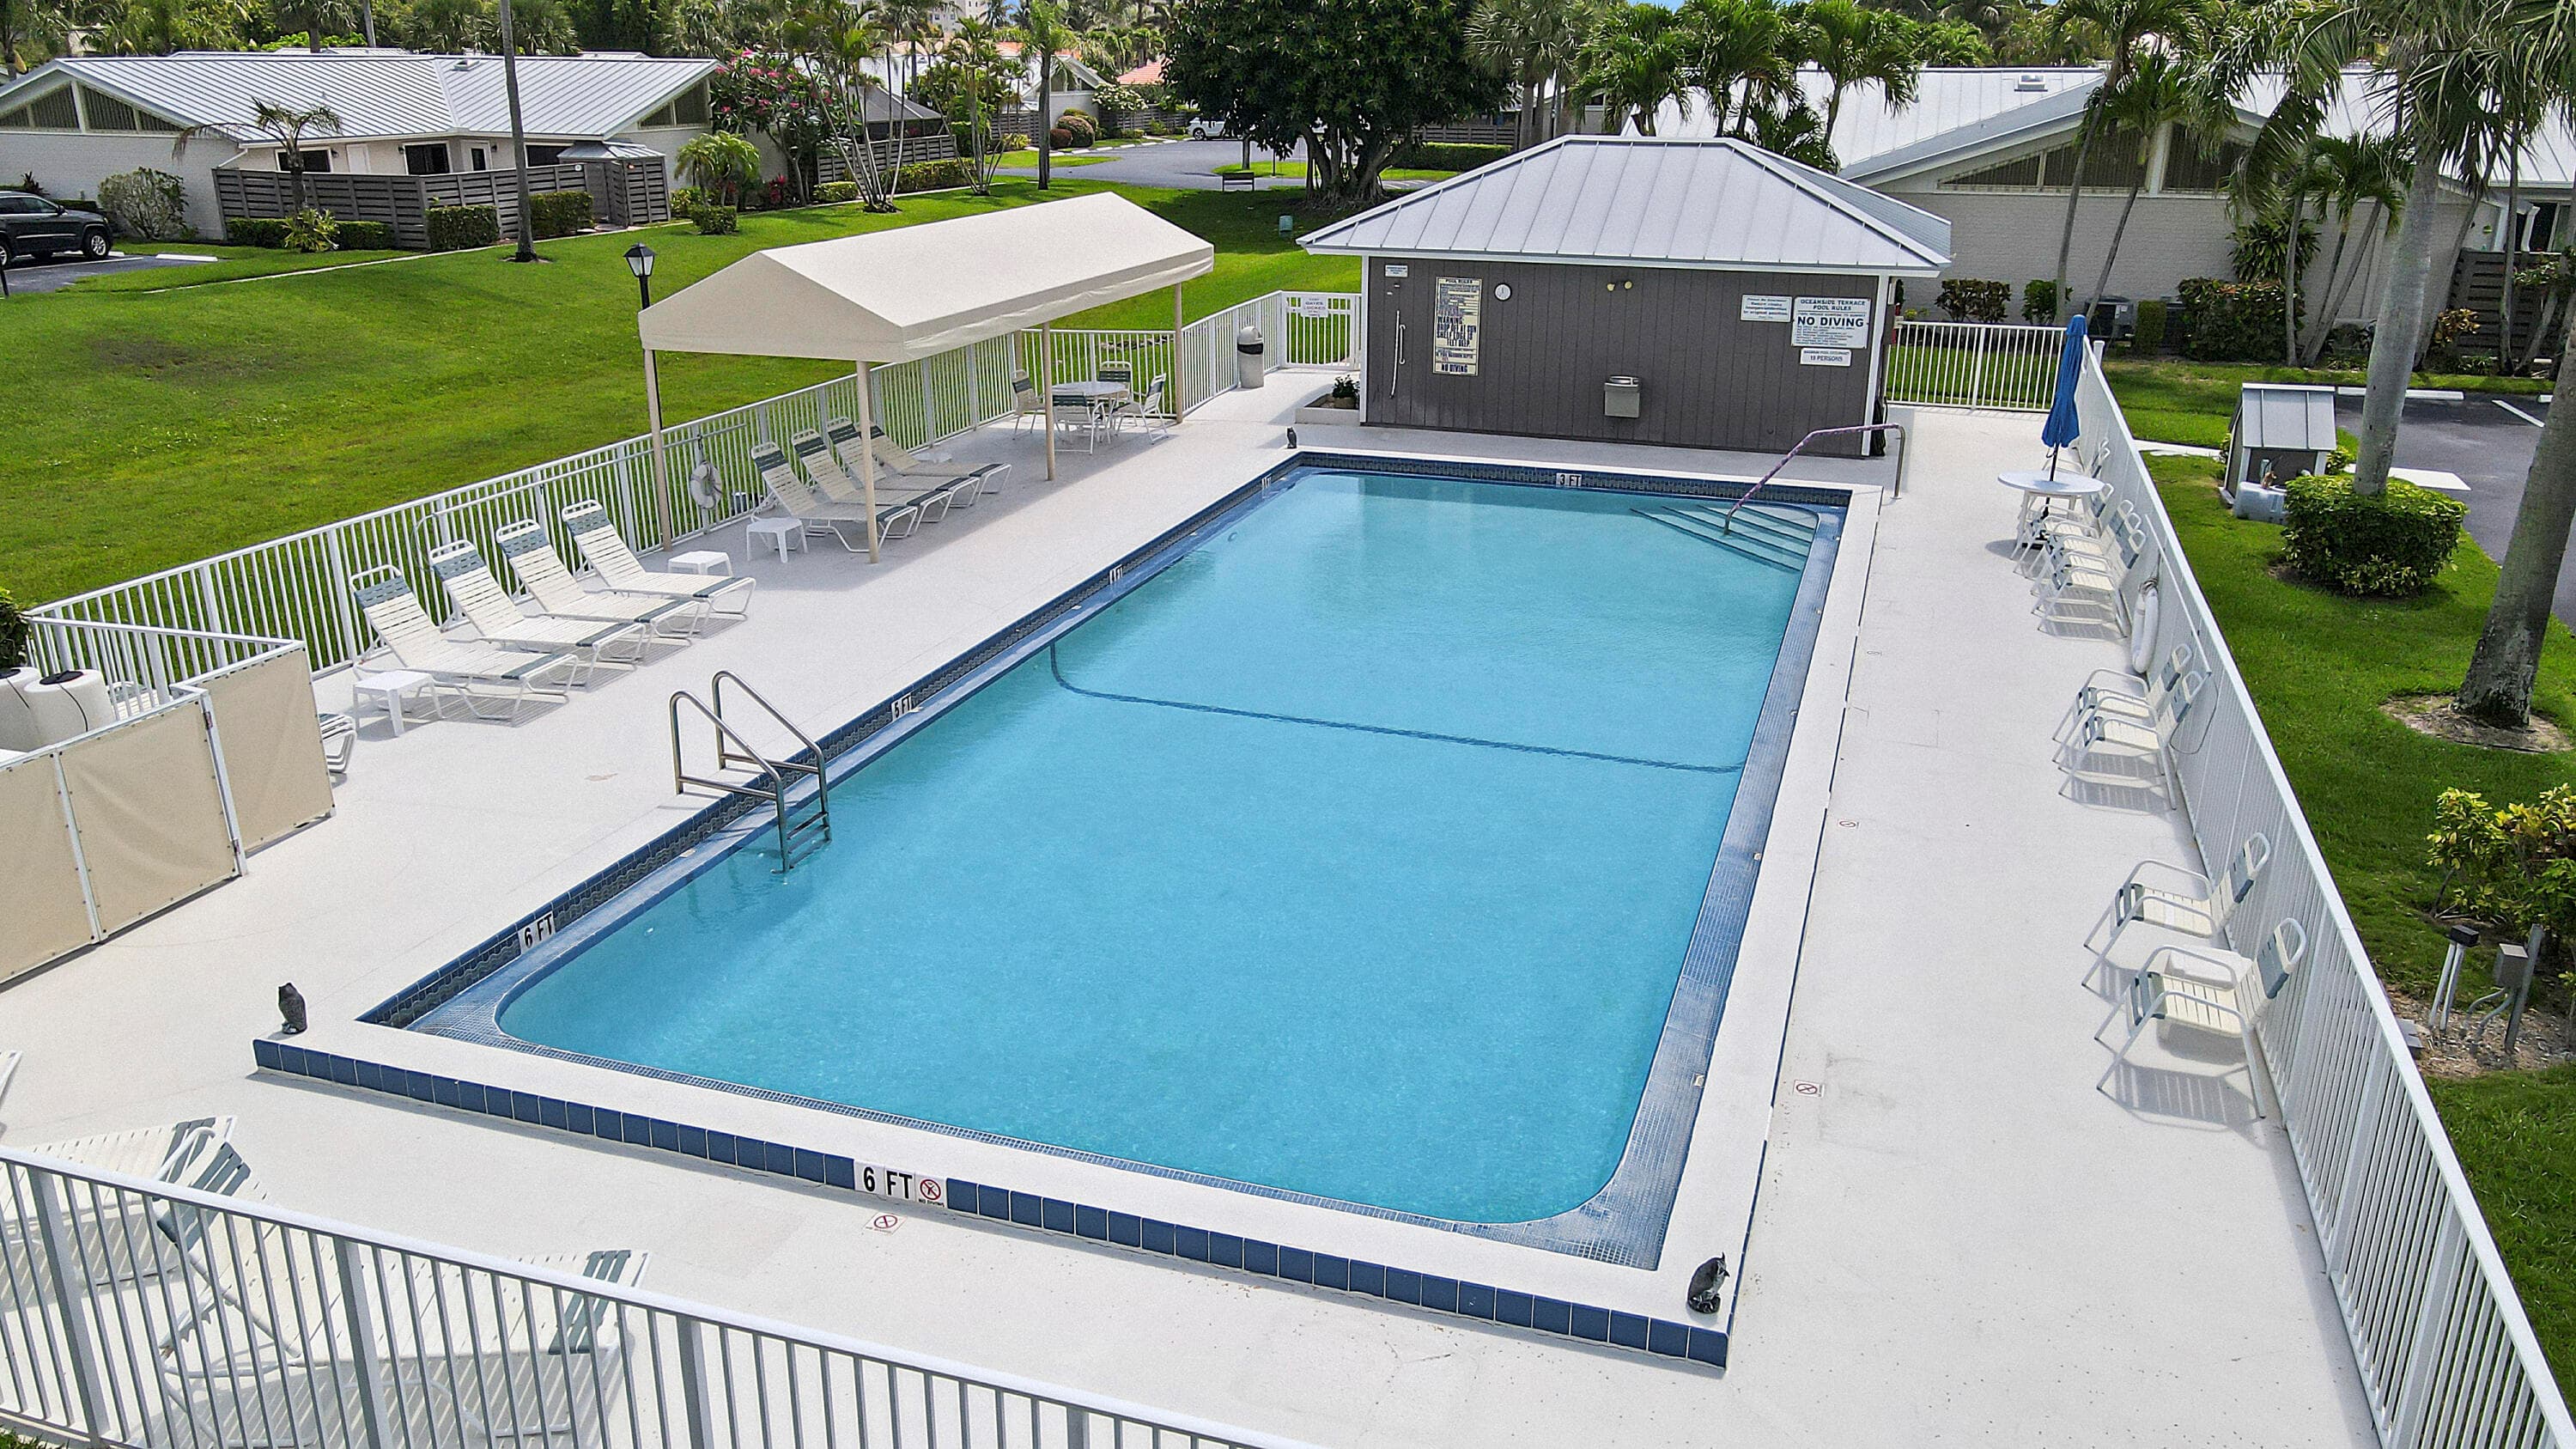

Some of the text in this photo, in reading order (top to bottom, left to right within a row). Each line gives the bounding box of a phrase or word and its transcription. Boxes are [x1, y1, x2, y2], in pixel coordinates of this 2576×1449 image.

[1797, 316, 1864, 327] NO DIVING
[1449, 364, 1468, 373] DIVING
[1559, 473, 1581, 487] 3 FT
[895, 695, 911, 718] 5 FT
[524, 913, 552, 948] 6 FT
[863, 1166, 913, 1199] 6 FT
